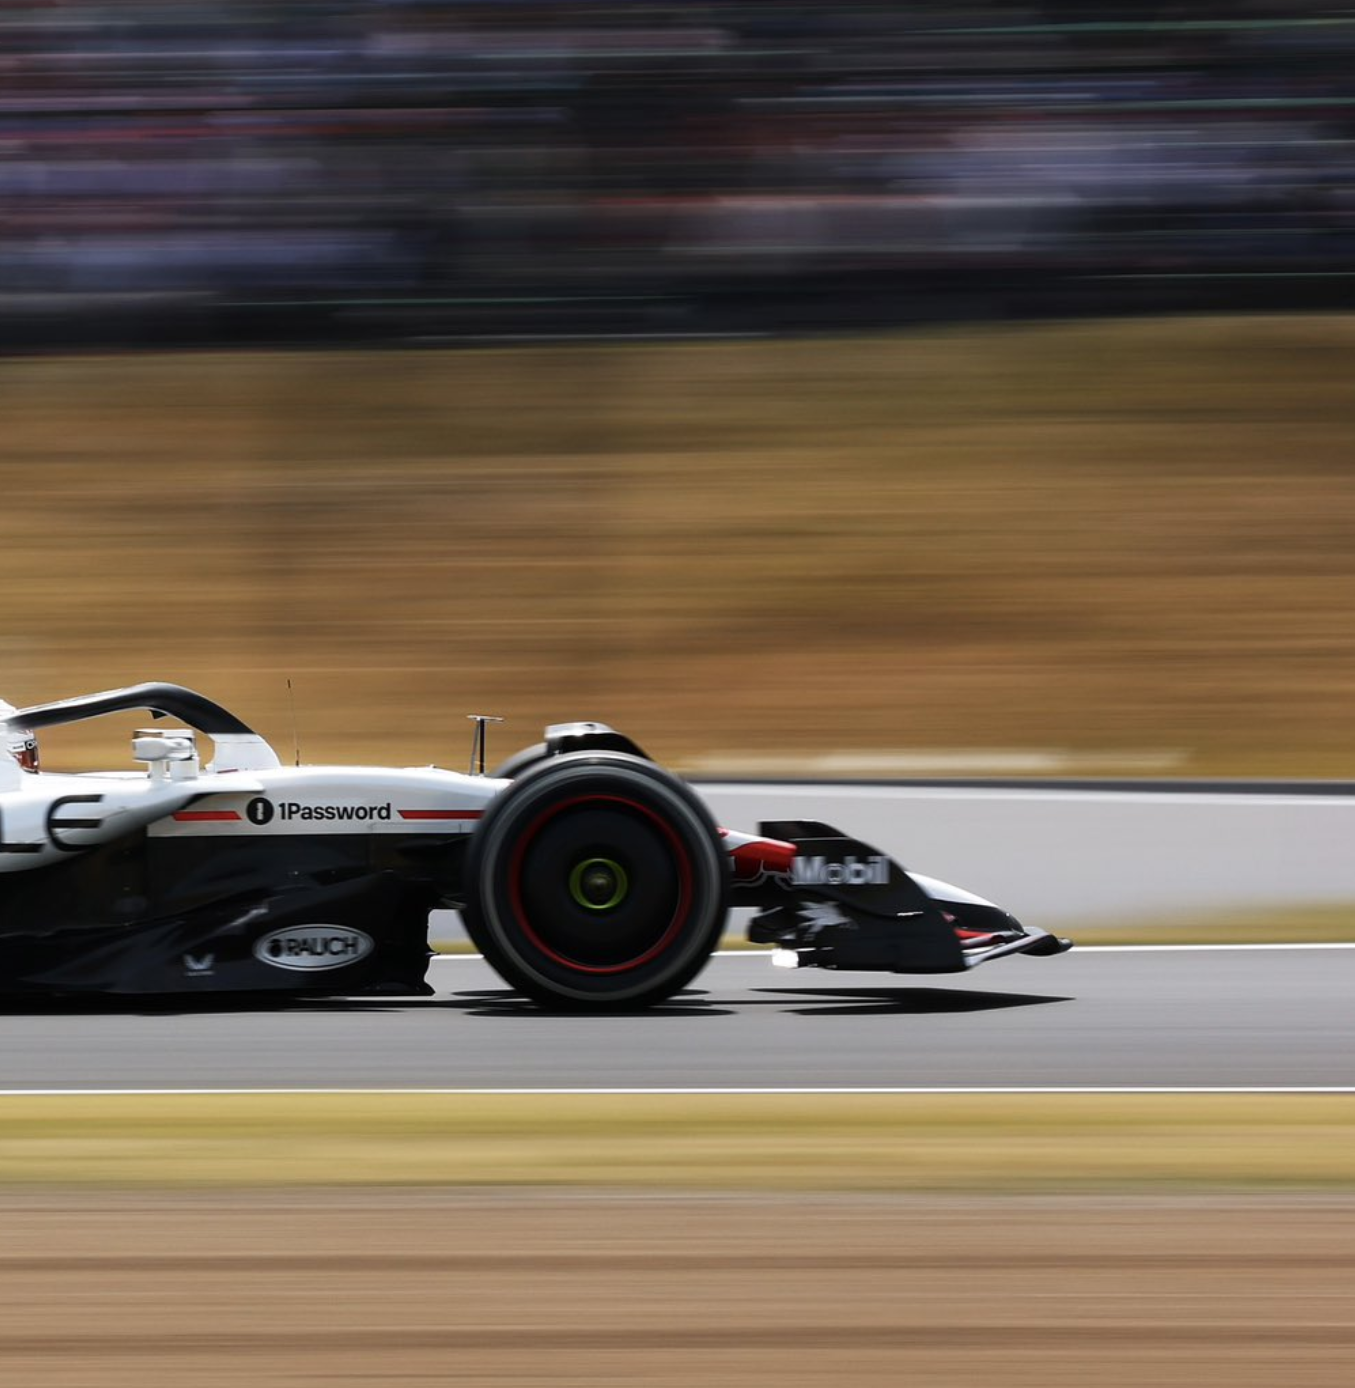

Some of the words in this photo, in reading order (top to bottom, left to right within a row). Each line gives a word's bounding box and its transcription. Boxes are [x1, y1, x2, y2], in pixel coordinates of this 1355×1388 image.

[278, 802, 392, 820] 1Password
[790, 856, 891, 884] Mobil
[287, 936, 359, 957] RAUCH
